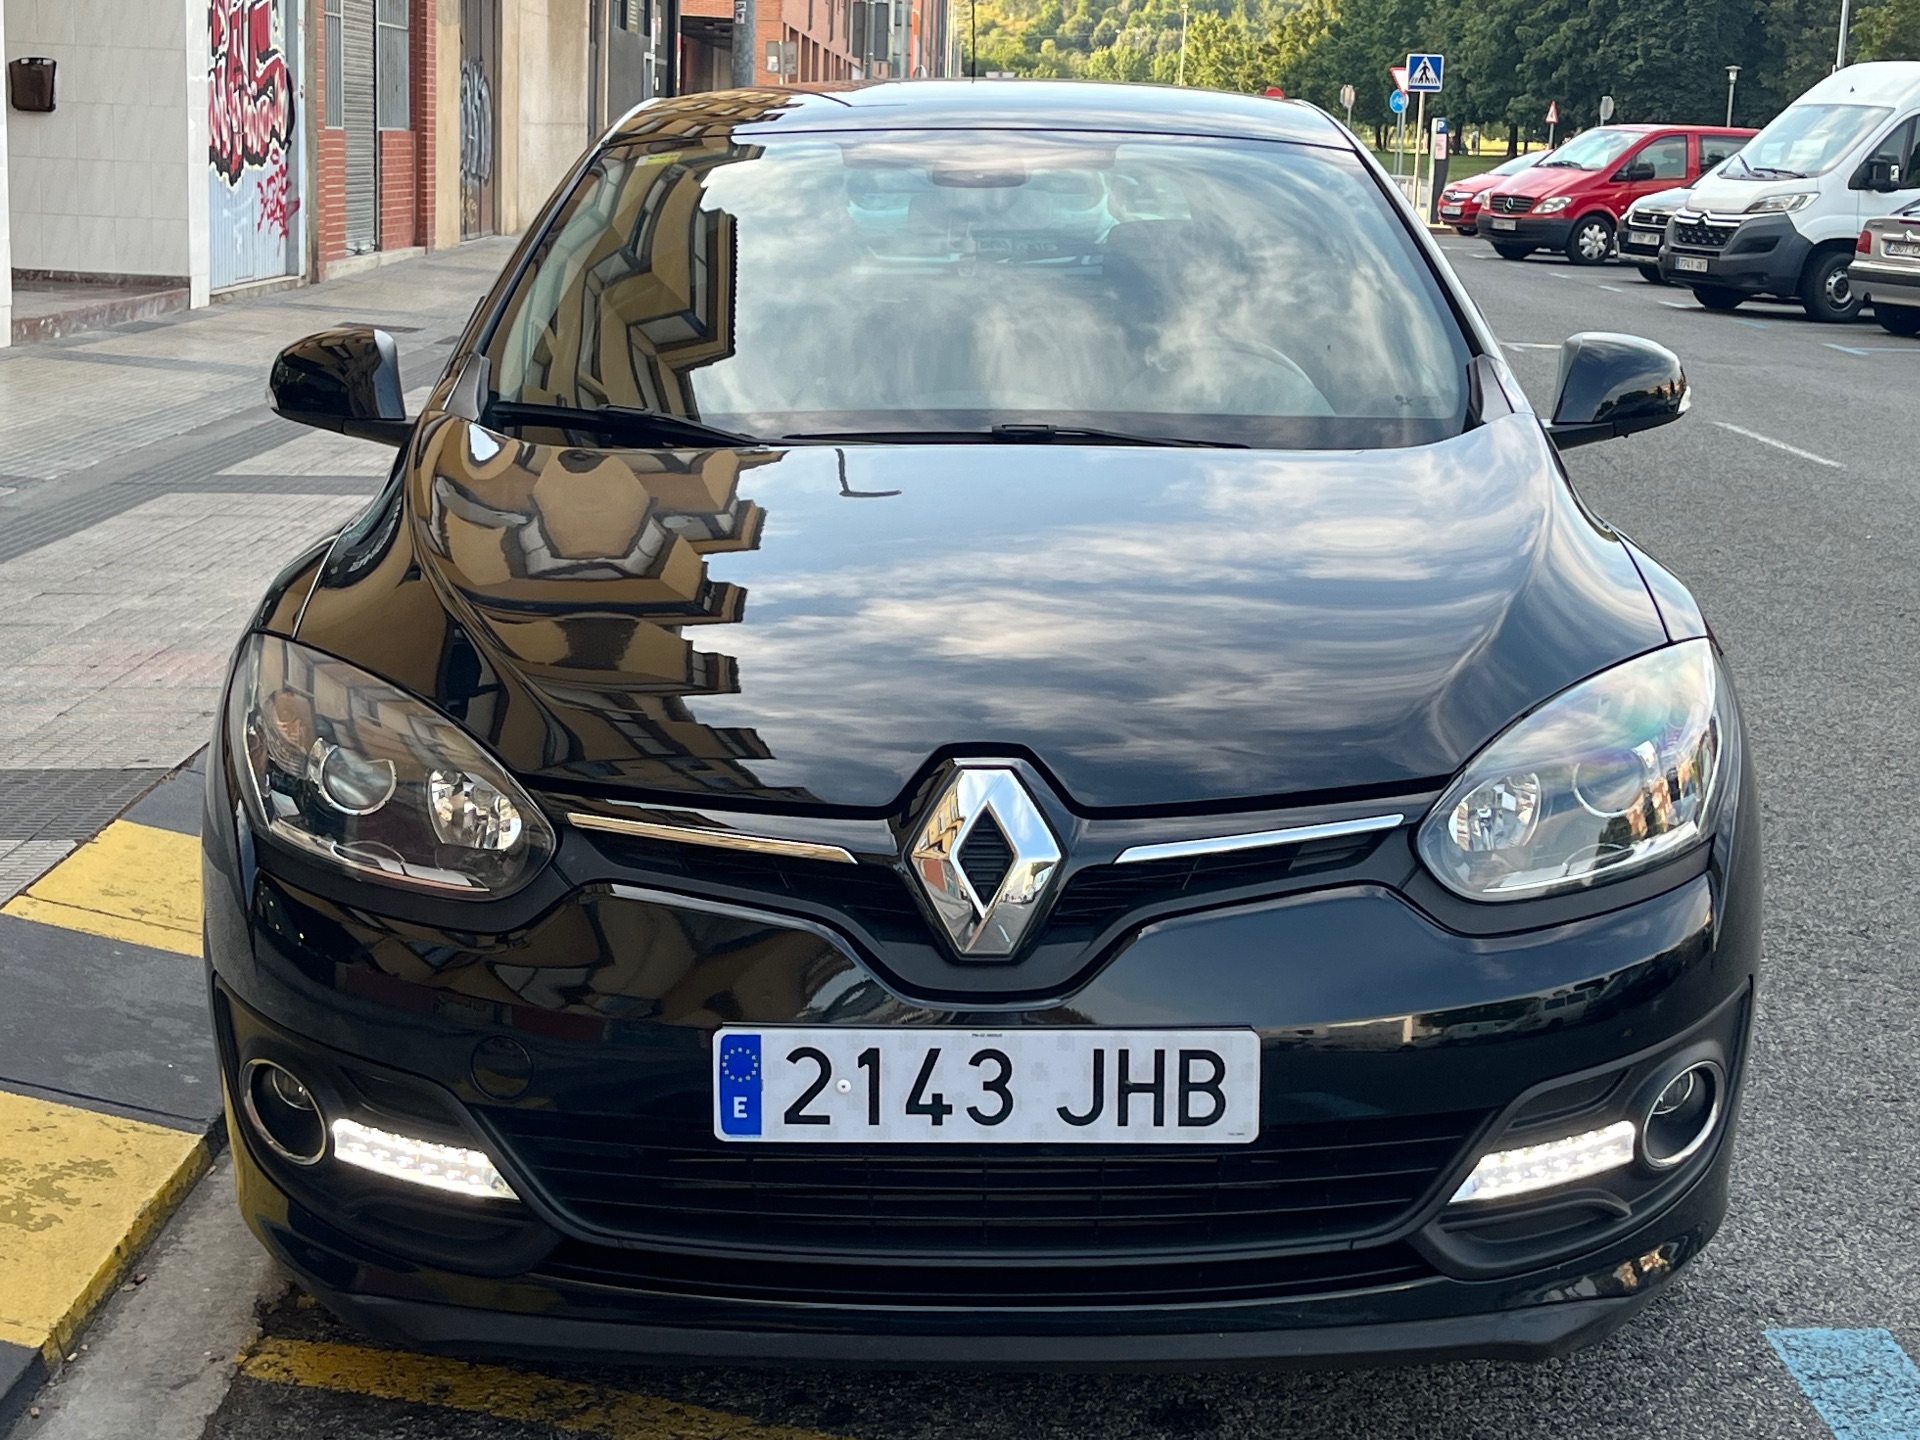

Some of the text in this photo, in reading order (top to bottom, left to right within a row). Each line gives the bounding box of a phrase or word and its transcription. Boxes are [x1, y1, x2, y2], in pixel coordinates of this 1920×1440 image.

[1437, 121, 1445, 132] P
[783, 1046, 1226, 1127] 2143 JHB
[733, 1096, 748, 1118] E
